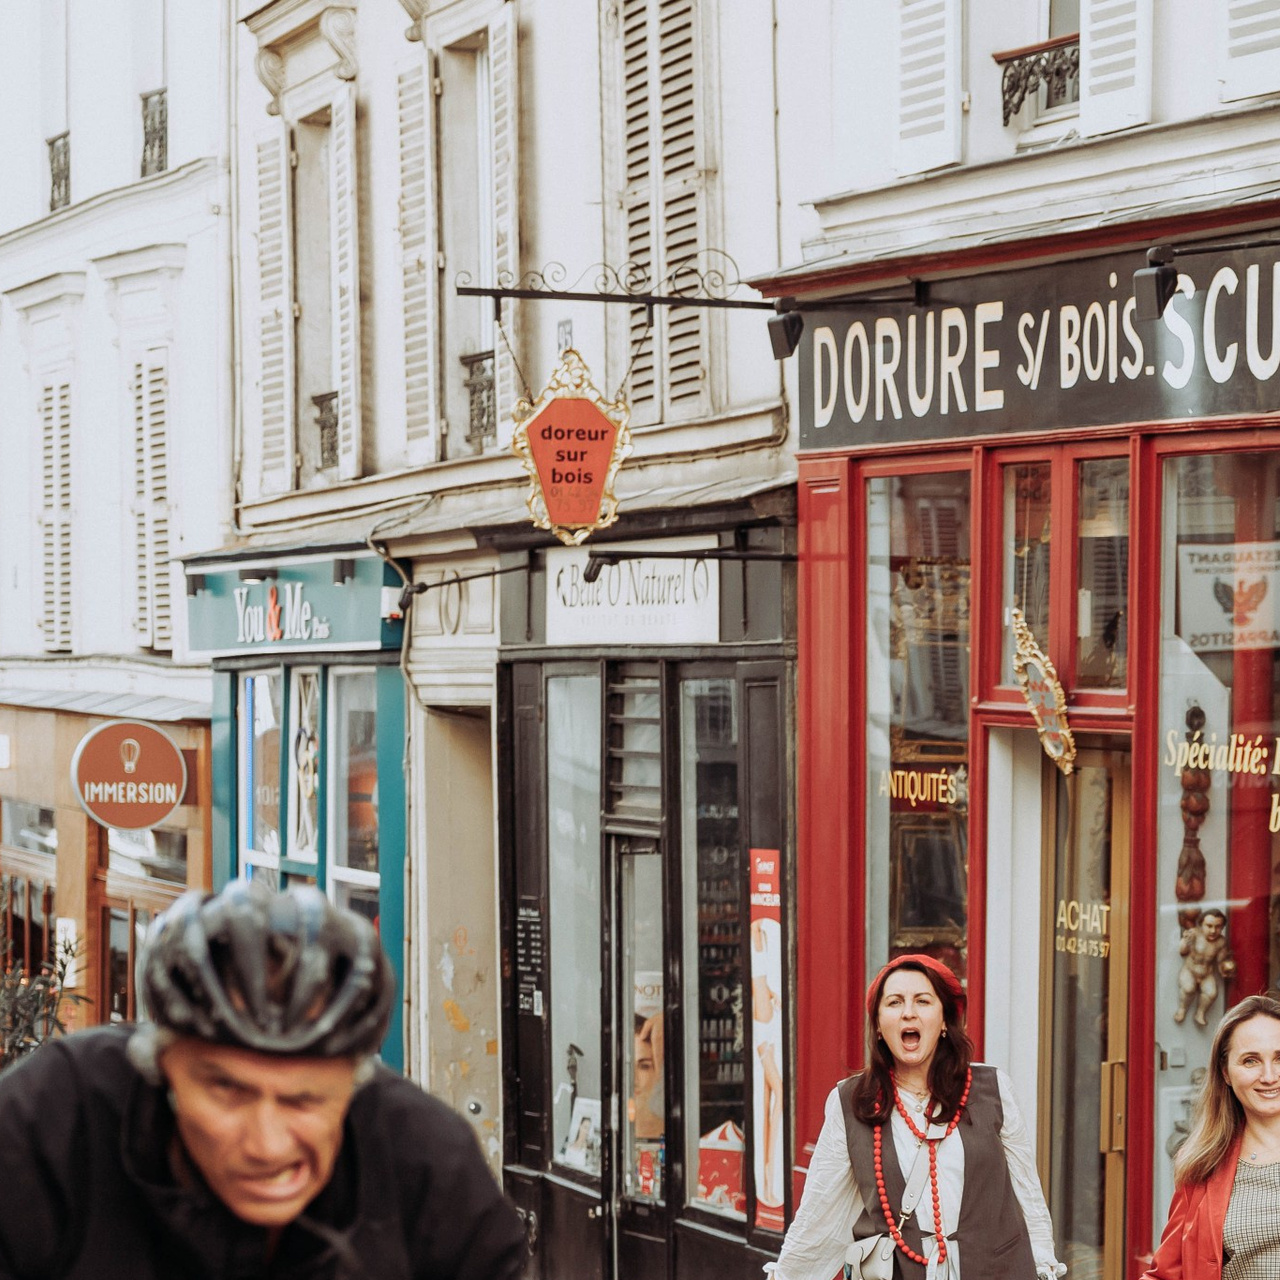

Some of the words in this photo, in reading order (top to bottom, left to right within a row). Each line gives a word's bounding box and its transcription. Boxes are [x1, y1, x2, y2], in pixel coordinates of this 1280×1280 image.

[813, 301, 1004, 428] DORURE
[540, 424, 609, 442] doreur
[555, 449, 588, 462] sur
[550, 467, 593, 485] bois
[626, 558, 687, 606] Naturel
[233, 586, 265, 644] You
[266, 584, 283, 642] &
[283, 581, 312, 641] Me
[1163, 729, 1269, 777] Spécialité:
[84, 781, 178, 804] IMMERSION
[878, 767, 958, 807] ANTIQUITÉS
[1056, 899, 1111, 936] ACHAT
